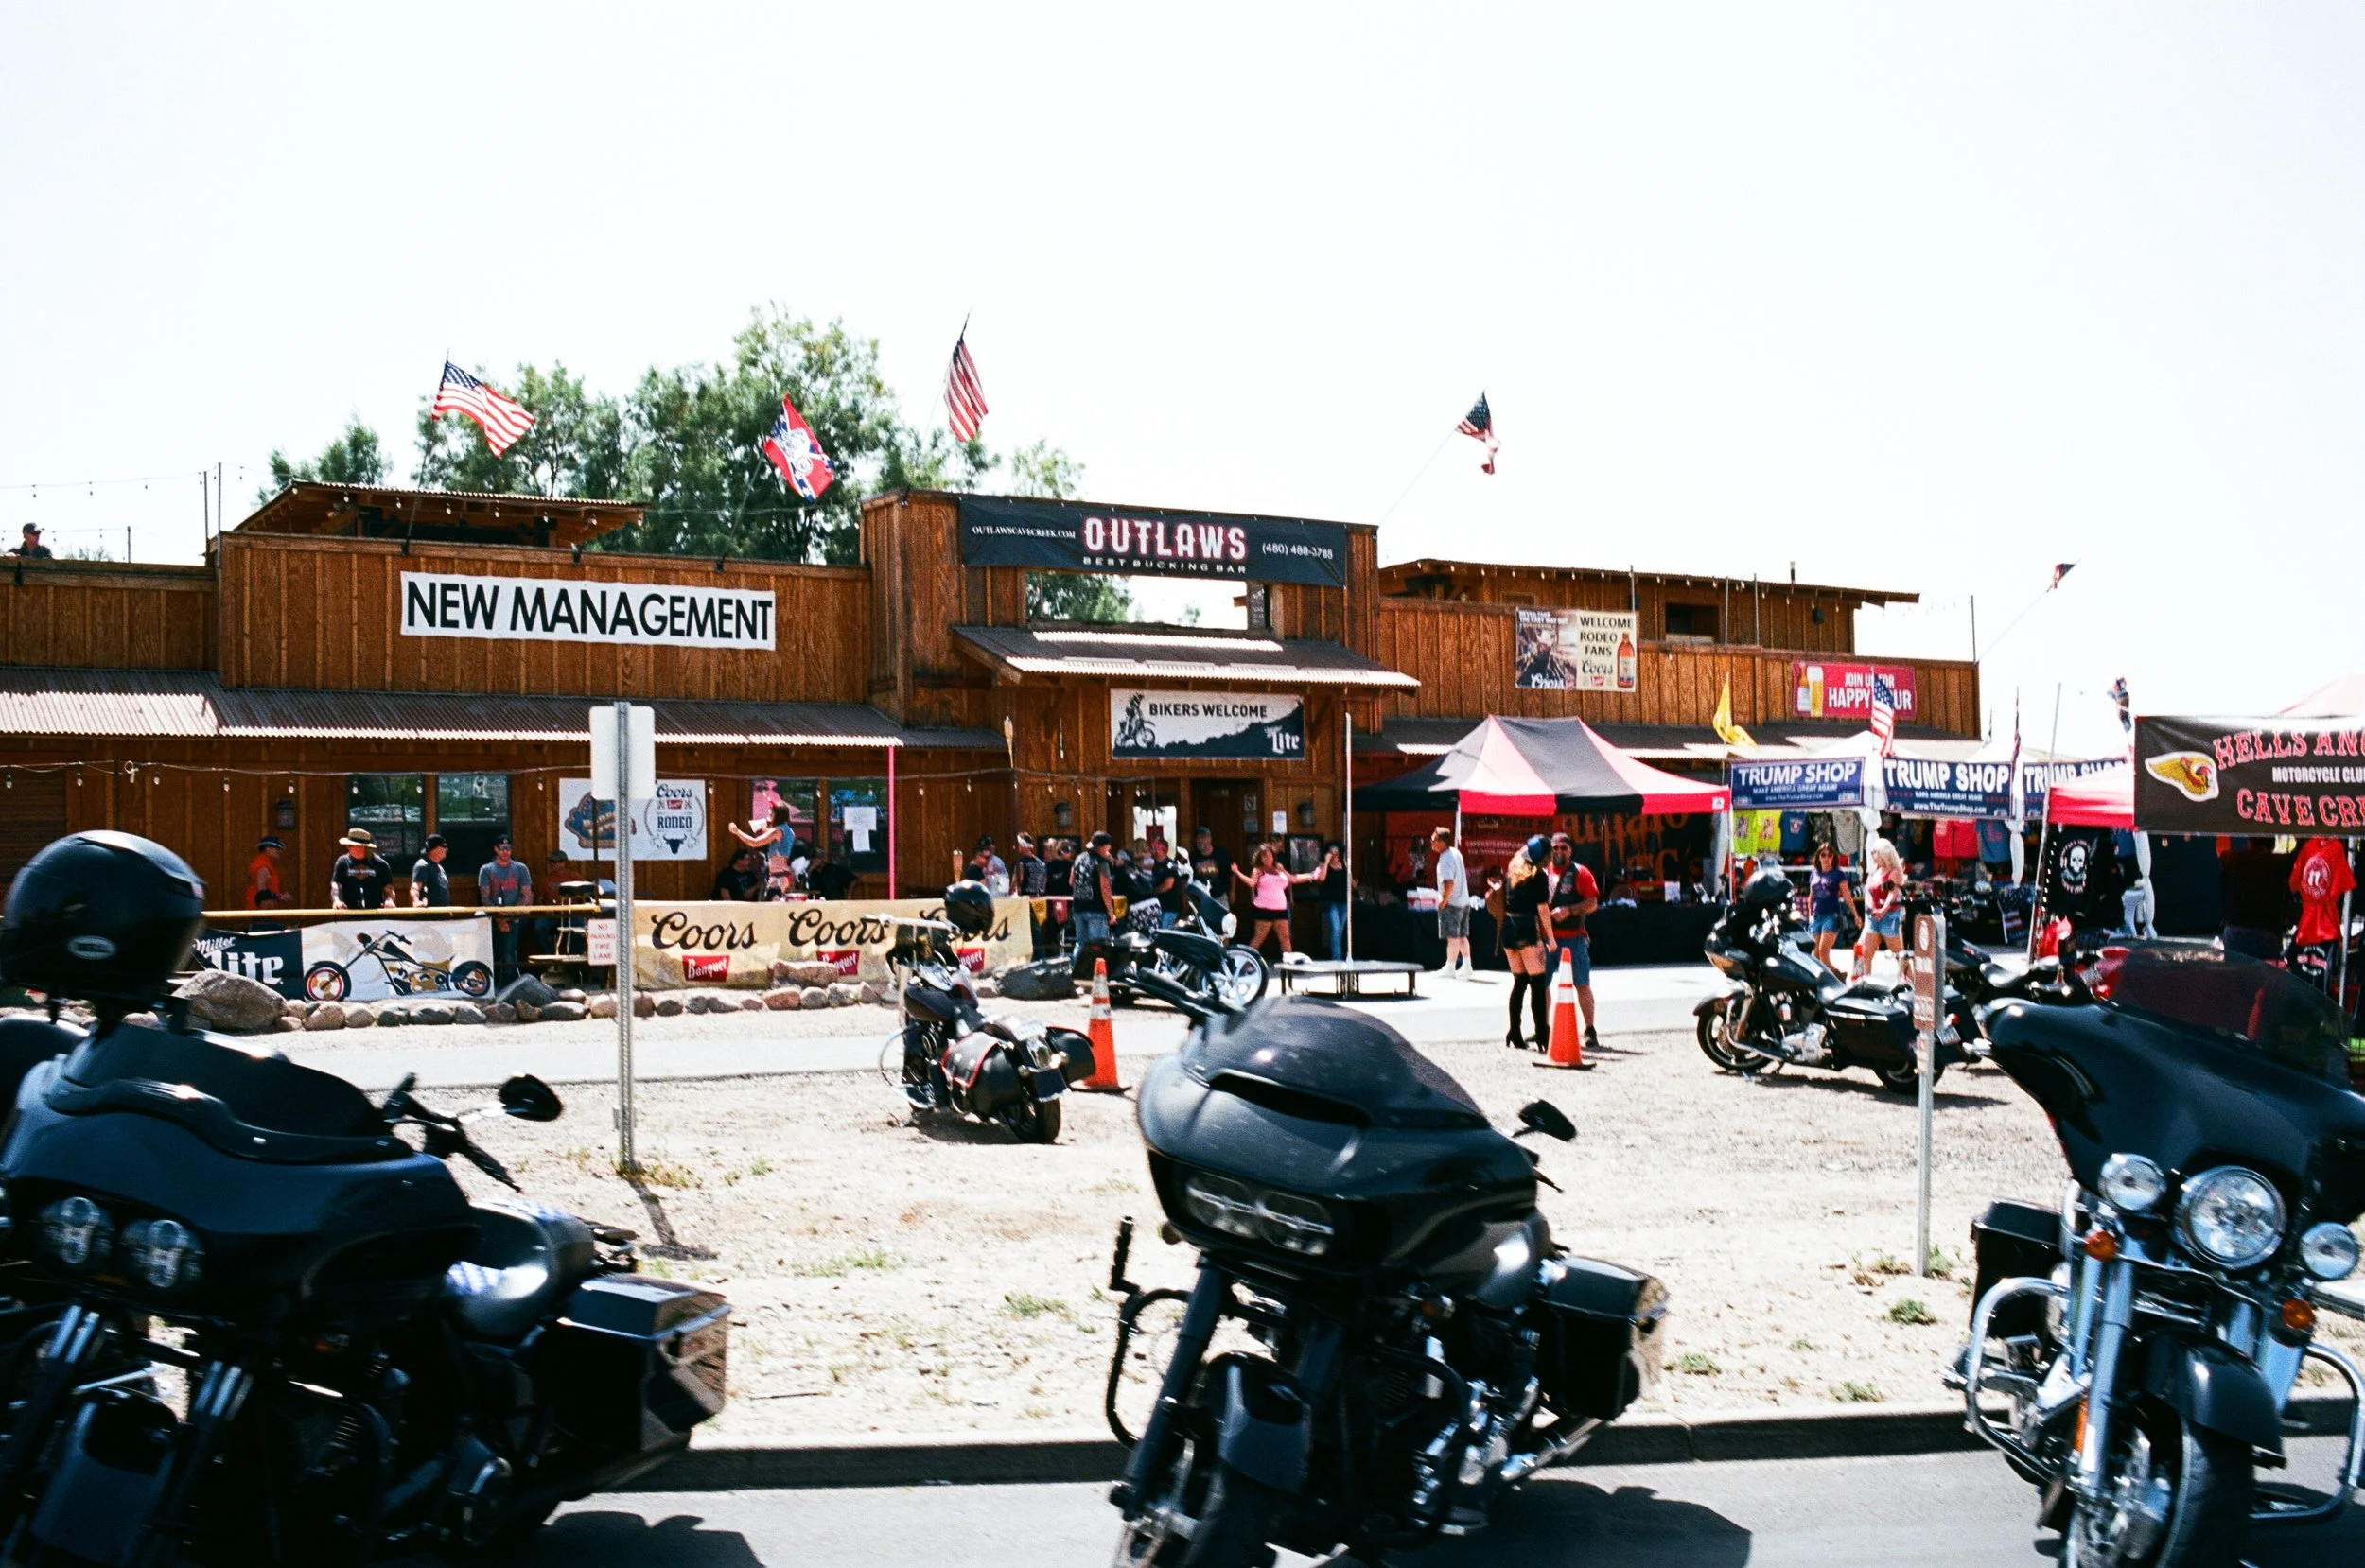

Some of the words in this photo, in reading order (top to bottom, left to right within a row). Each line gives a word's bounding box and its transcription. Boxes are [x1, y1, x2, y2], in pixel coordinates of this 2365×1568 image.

[972, 524, 1077, 540] OUTLAWSCAVECREEK.COM
[1082, 516, 1247, 561] OUTLAWS
[1262, 542, 1288, 556] (480)
[1082, 556, 1126, 567] BEST
[1132, 559, 1209, 572] BUCKING
[1216, 564, 1246, 574] BAR
[407, 580, 499, 630] NEW
[509, 585, 773, 641] MANAGEMENT
[1579, 616, 1633, 629] WELCOME
[1579, 632, 1618, 643] RODEO
[1585, 645, 1612, 656] FANS
[1582, 659, 1613, 675] Coors
[1845, 672, 1864, 688] JOIN
[1828, 687, 1871, 709] HAPPY
[1148, 703, 1200, 717] BIKERS
[1202, 704, 1268, 719] WELCOME
[1268, 731, 1300, 754] Lite
[2213, 729, 2308, 770] HELLS
[2313, 730, 2365, 757] AN
[1738, 765, 1803, 787] TRUMP
[1804, 761, 1857, 784] SHOP
[1883, 758, 1951, 791] TRUMP
[1955, 763, 2009, 793] SHOP
[2272, 766, 2341, 783] MOTORCYCLE
[2342, 766, 2365, 784] CLU
[656, 783, 692, 798] Coors
[2236, 788, 2315, 827] CAVE
[657, 815, 692, 829] RODEO
[651, 911, 757, 950] Coors
[788, 908, 890, 947] Coors
[192, 935, 236, 955] Miller
[687, 956, 727, 980] Banquet
